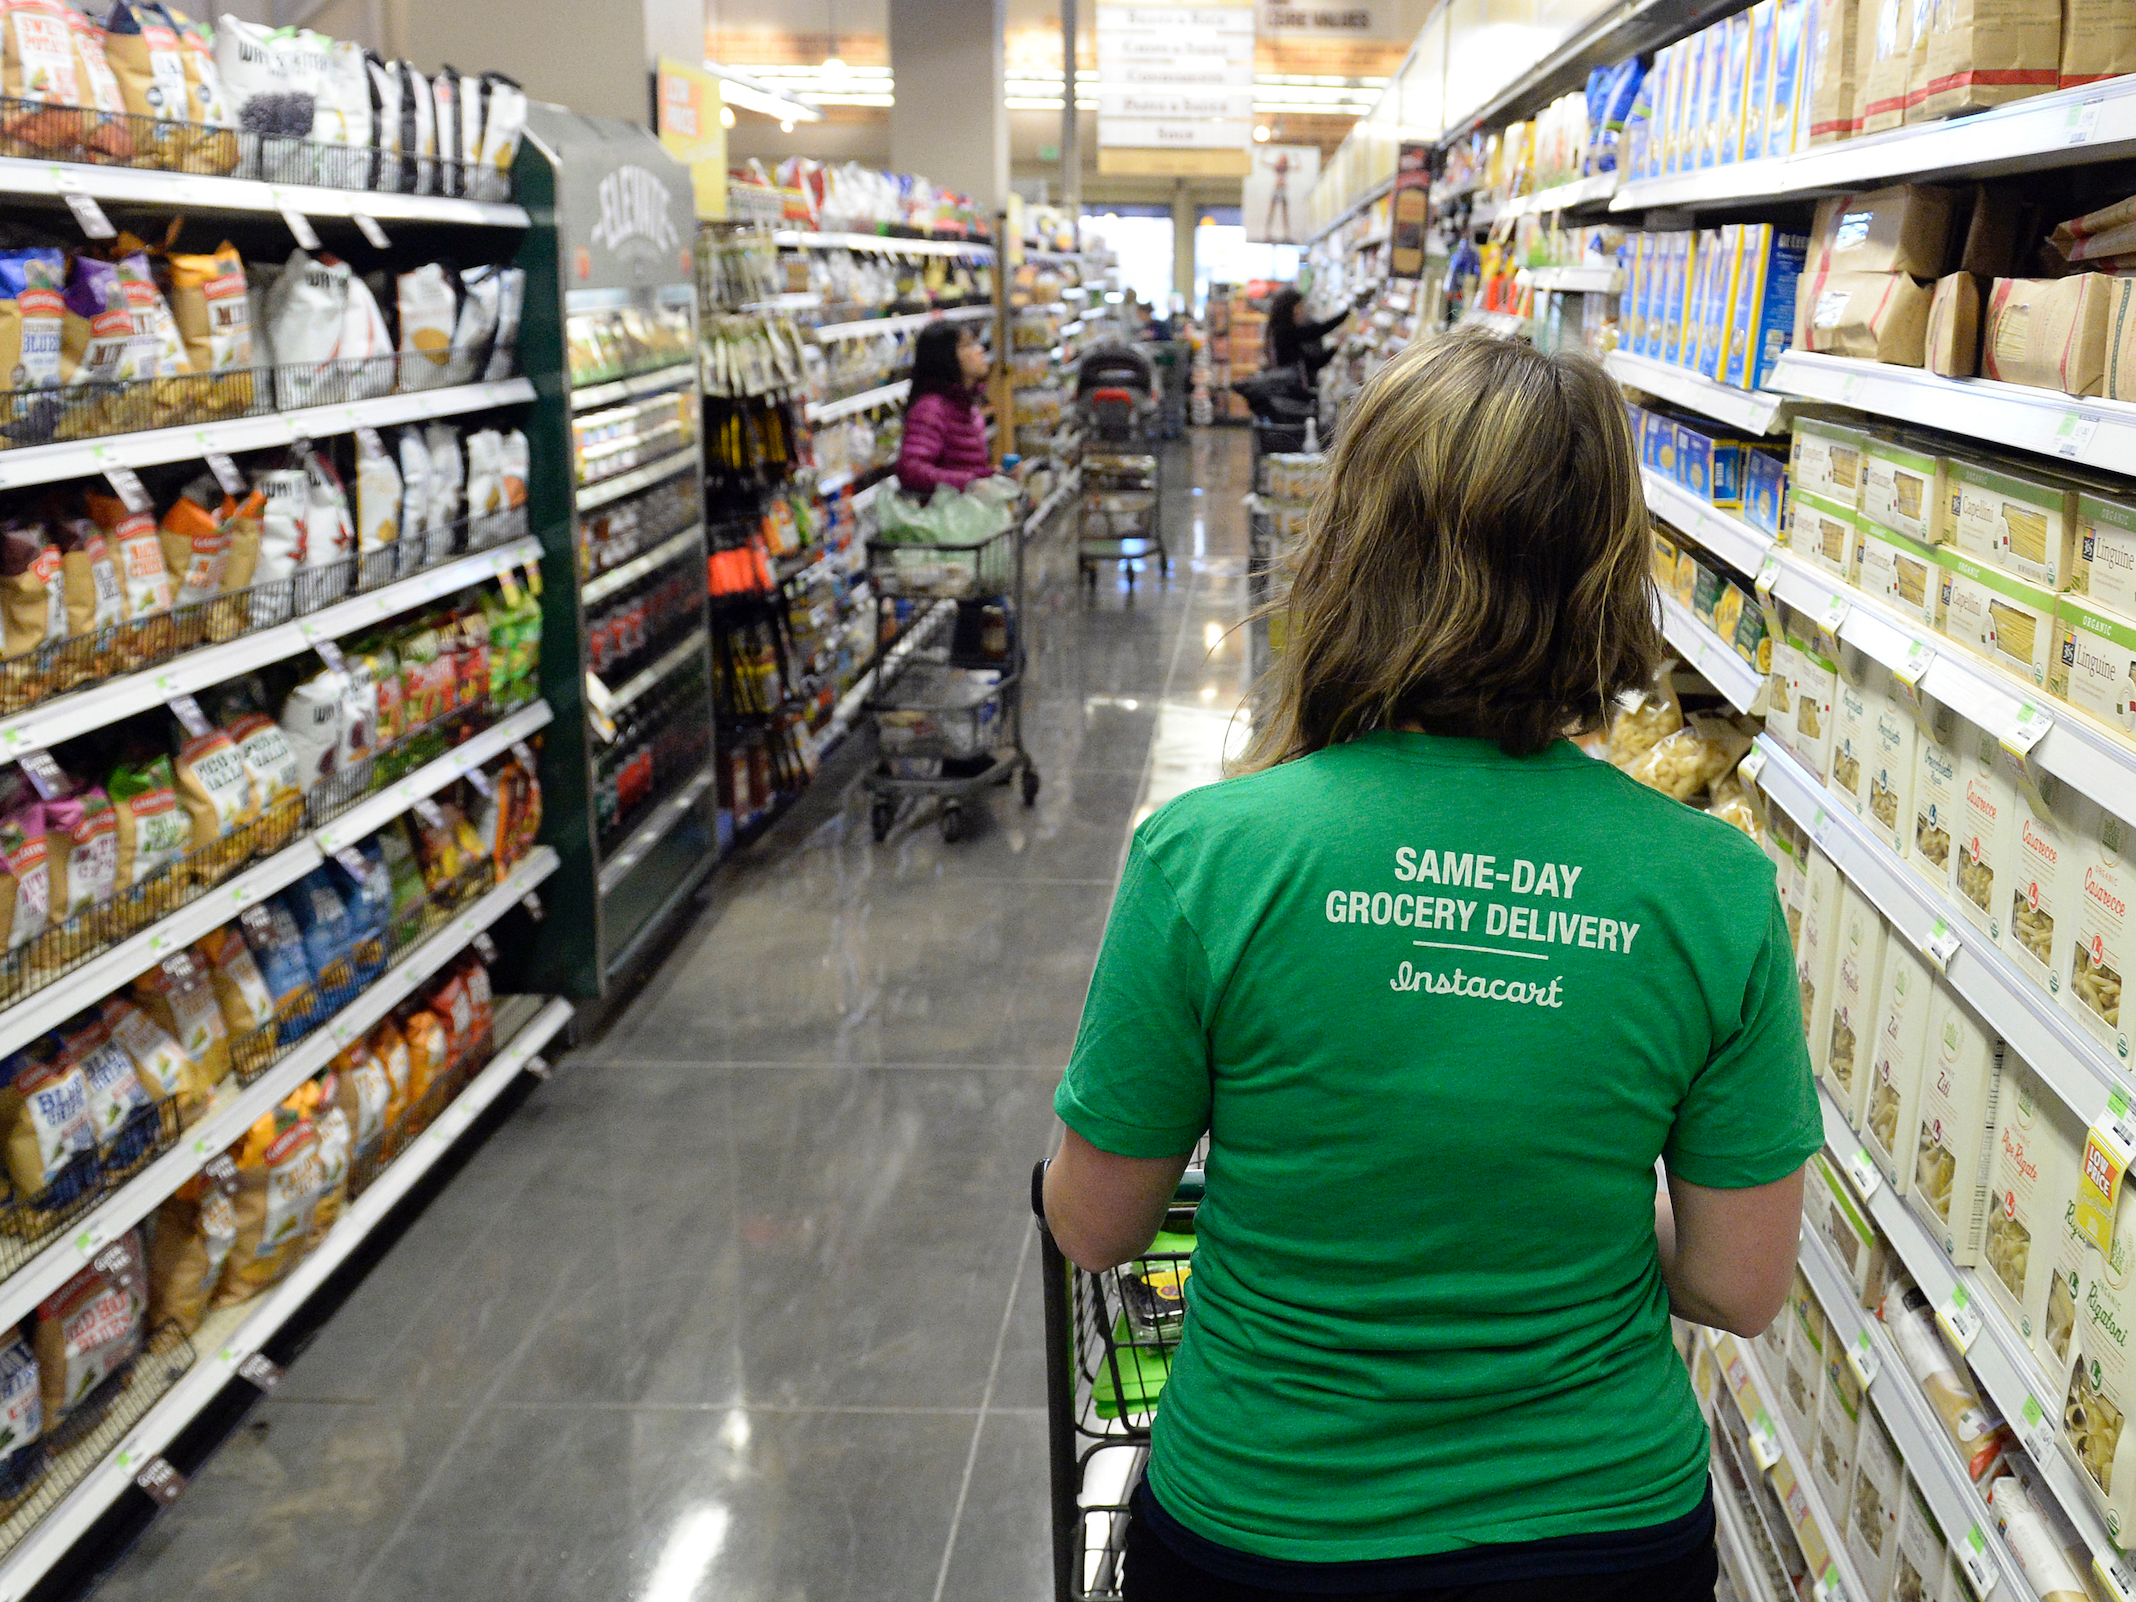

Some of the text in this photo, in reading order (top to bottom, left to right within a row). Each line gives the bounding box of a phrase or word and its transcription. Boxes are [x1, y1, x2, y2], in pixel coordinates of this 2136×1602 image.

[1962, 495, 1995, 523] Capellini
[2095, 537, 2135, 572] Linguine
[2082, 615, 2113, 637] ORGANIC
[2076, 643, 2116, 682] Linguine
[1966, 780, 1997, 820] Casarecce
[2022, 819, 2059, 864] Casarecce
[1394, 846, 1583, 899] SAME-DAY
[2084, 867, 2126, 917] Casarecce
[1325, 890, 1641, 954] GROCERY DELIVERY
[1390, 961, 1563, 1008] Instacart
[1937, 1071, 1951, 1098] Ziti
[2001, 1127, 2038, 1182] Pipe Rigate
[2089, 1145, 2109, 1175] LOW
[2086, 1160, 2111, 1198] PRICE
[2086, 1281, 2128, 1347] Rigatoni
